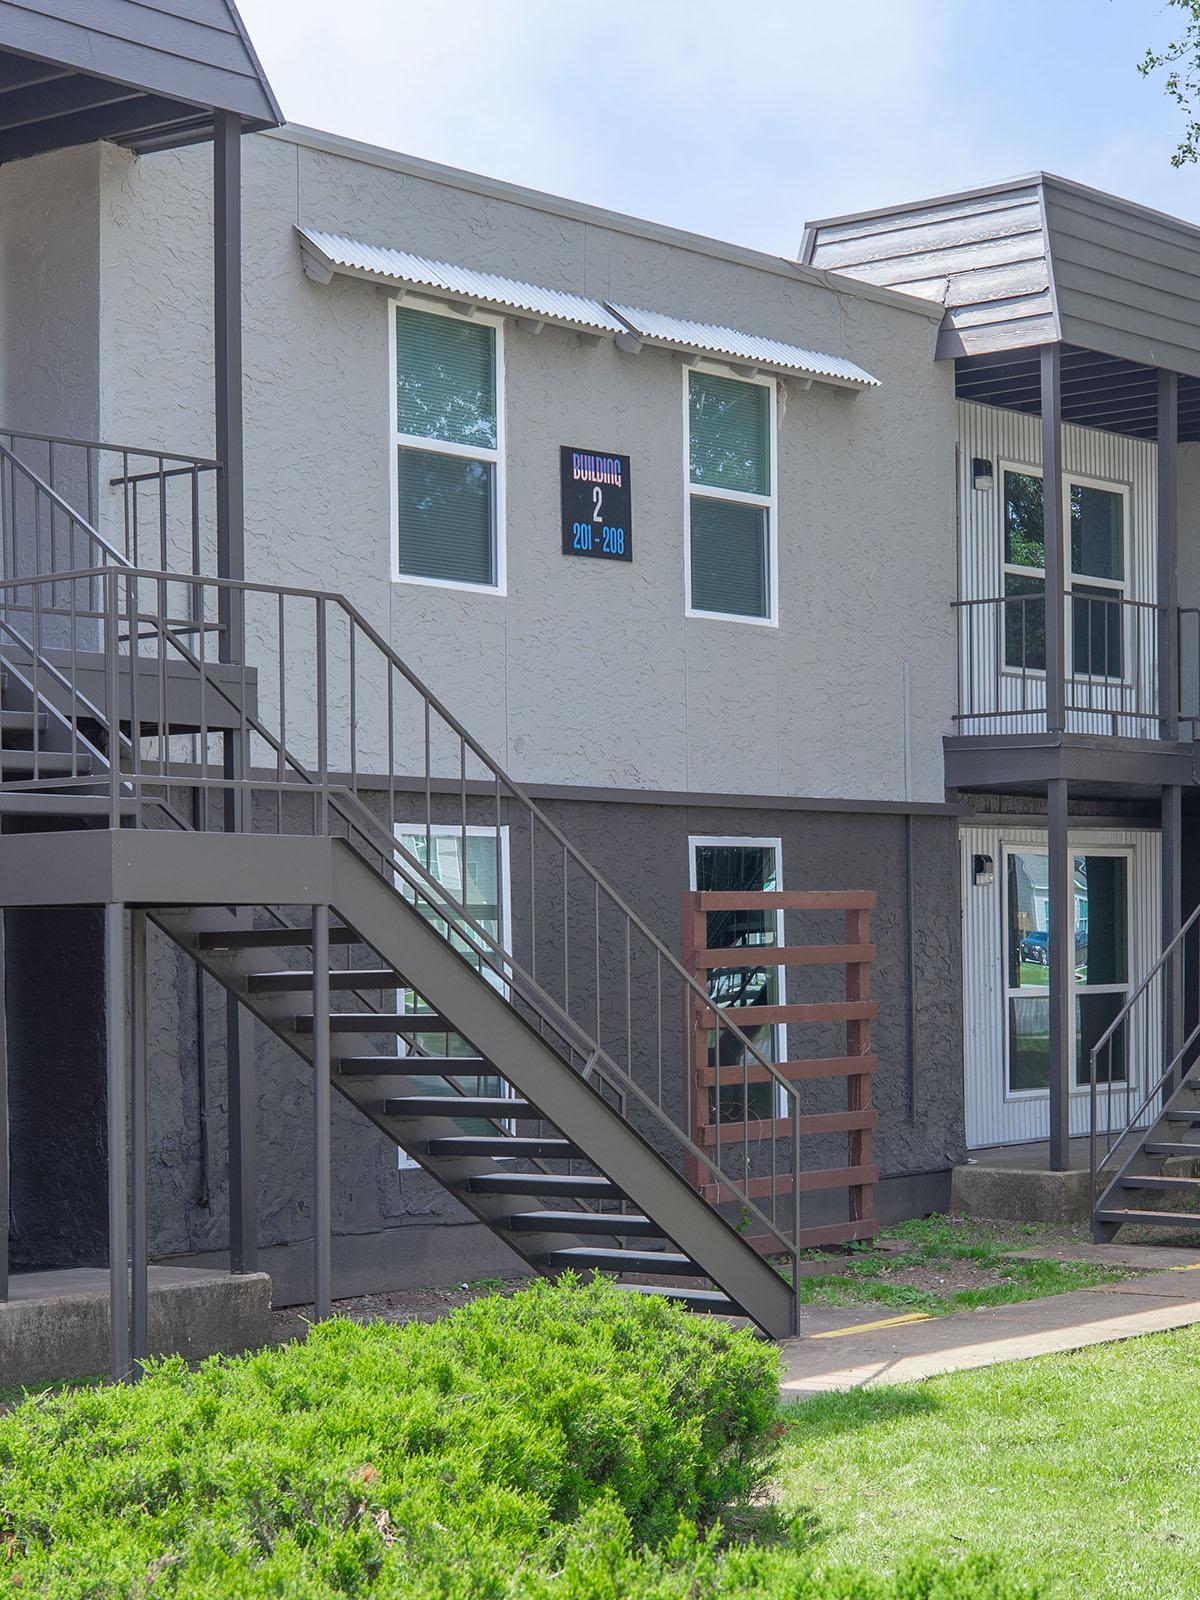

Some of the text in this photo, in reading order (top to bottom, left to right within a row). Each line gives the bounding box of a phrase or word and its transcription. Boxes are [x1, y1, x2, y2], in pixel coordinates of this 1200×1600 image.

[573, 453, 621, 487] BUILDING
[593, 486, 602, 522] 2
[573, 523, 592, 550] 201
[602, 526, 624, 554] 208
